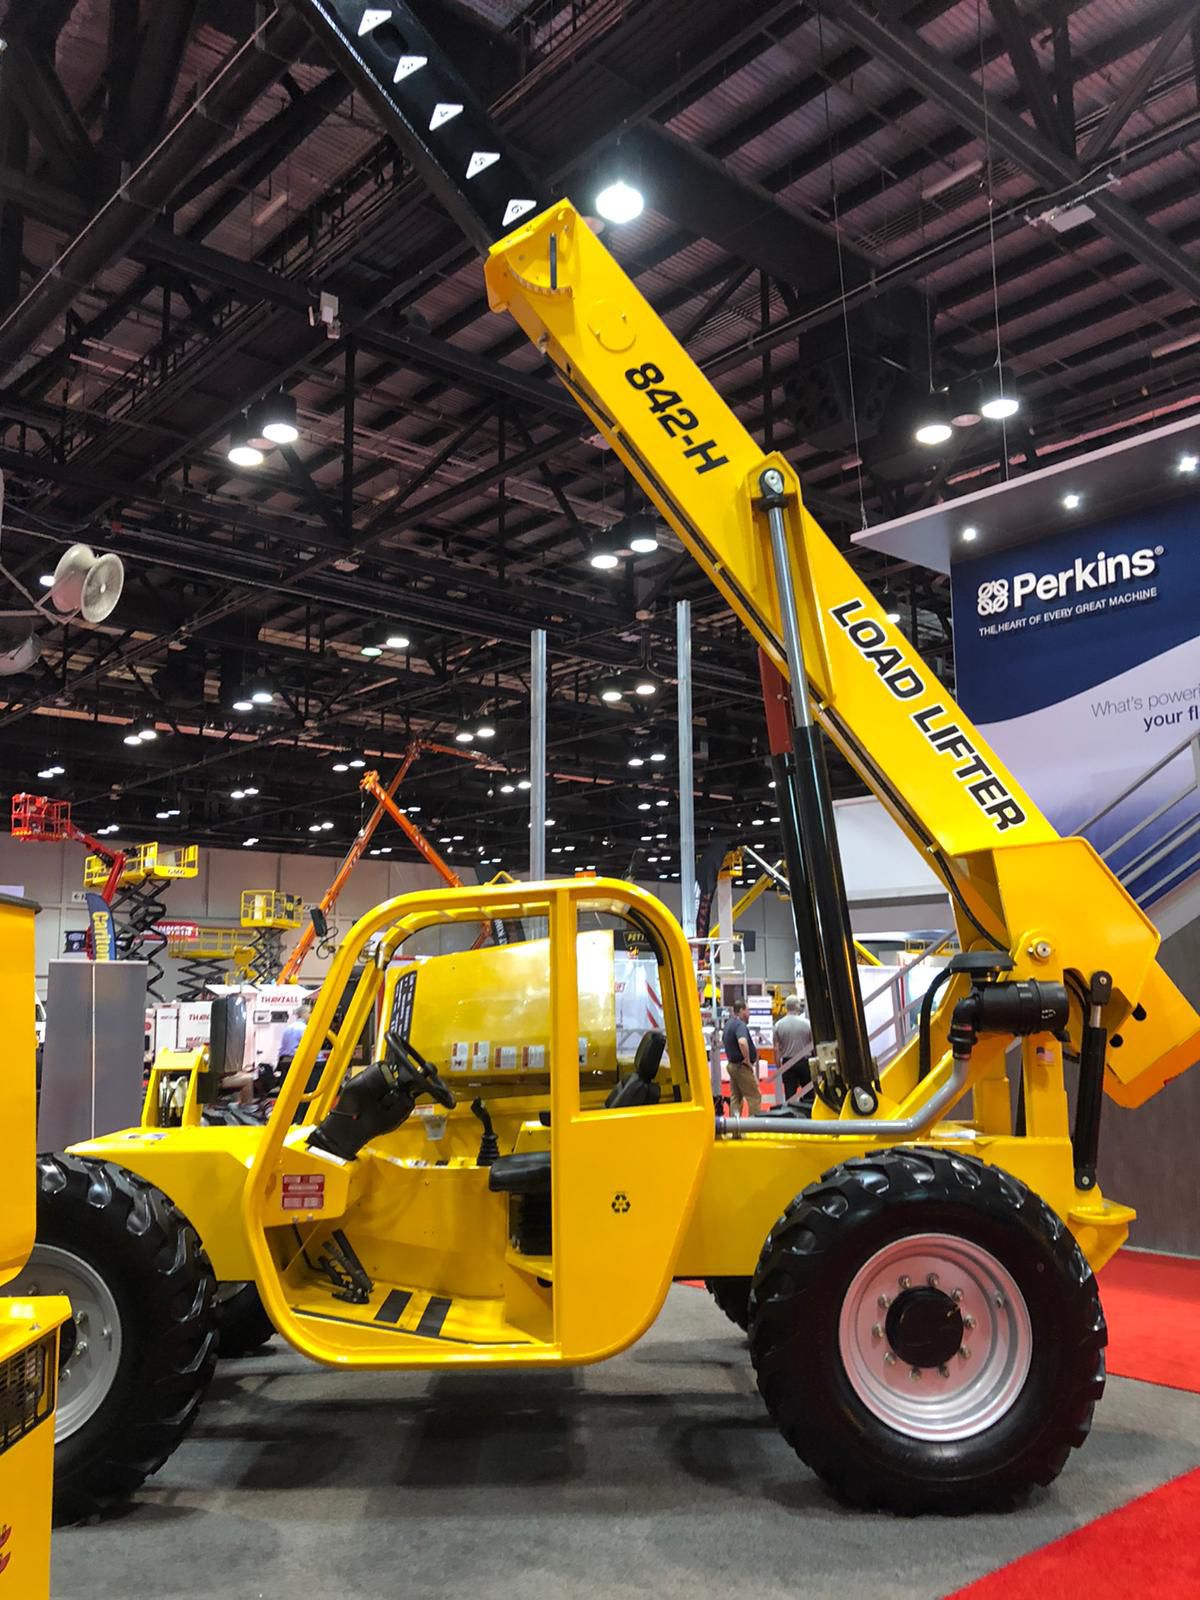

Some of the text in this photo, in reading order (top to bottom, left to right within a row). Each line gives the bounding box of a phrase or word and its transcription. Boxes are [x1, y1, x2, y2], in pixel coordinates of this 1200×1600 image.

[625, 362, 730, 475] 842-H
[979, 587, 1158, 637] THE HEART OF EVERY GREAT MACHINE
[829, 598, 1028, 832] LOAD LIFTER
[1091, 695, 1143, 718] What's
[1143, 710, 1183, 733] your
